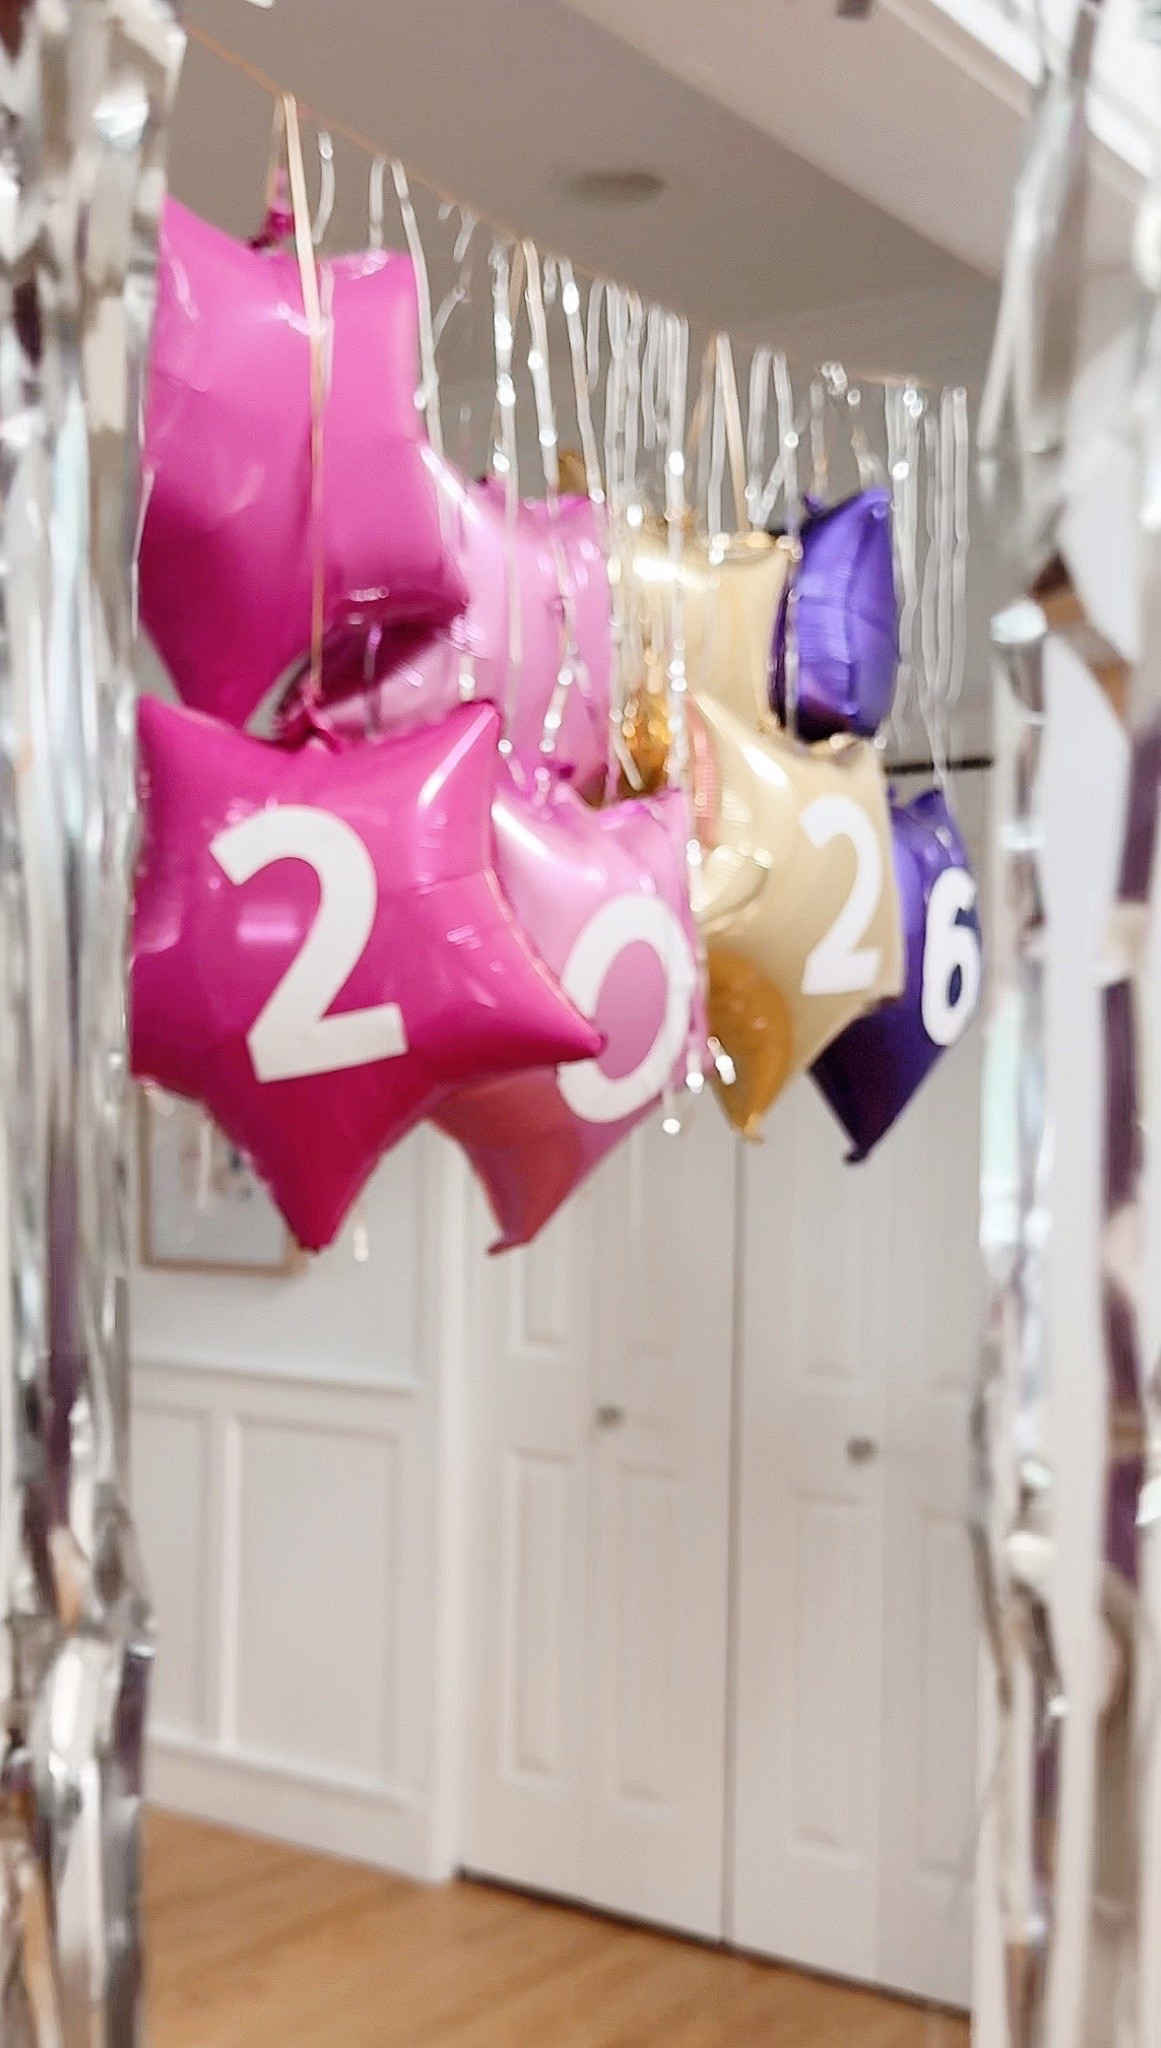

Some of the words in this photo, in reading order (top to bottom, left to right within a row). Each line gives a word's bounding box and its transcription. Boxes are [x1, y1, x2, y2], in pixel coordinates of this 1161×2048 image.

[210, 804, 408, 1083] 2
[800, 794, 883, 995] 2
[921, 866, 982, 1046] 6
[557, 895, 696, 1123] 0
